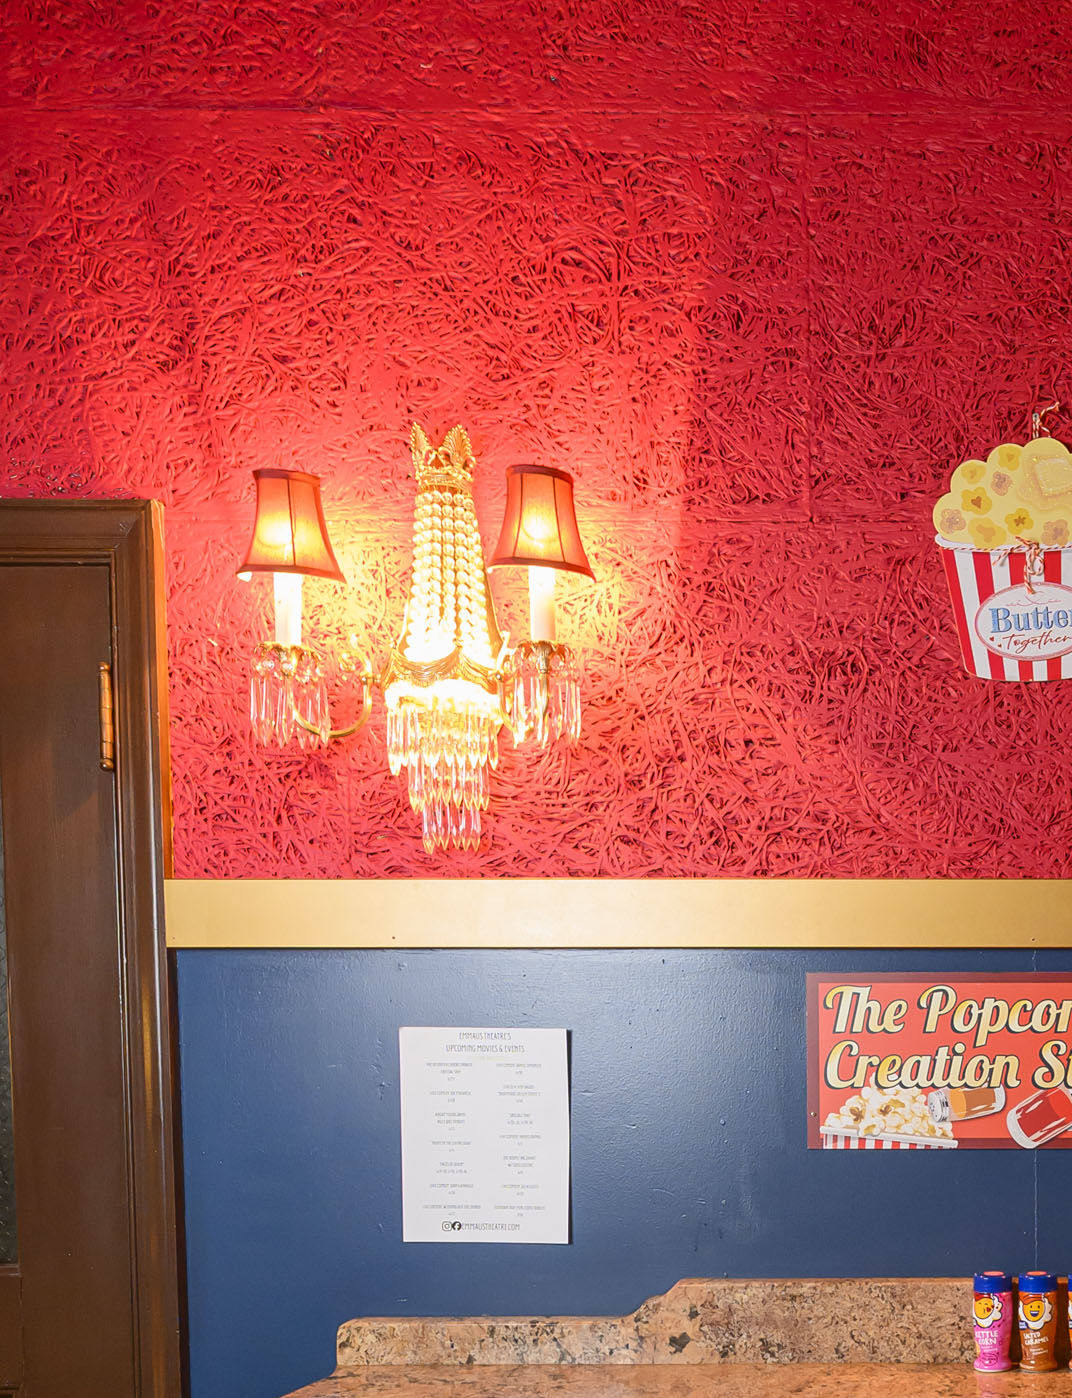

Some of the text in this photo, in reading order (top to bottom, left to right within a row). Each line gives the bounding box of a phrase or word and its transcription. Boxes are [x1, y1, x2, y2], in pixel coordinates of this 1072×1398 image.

[824, 985, 908, 1034] The
[445, 1044, 476, 1054] UPCOMING
[477, 1044, 499, 1054] MOVIES
[504, 1045, 525, 1054] EVENTS
[458, 1031, 484, 1041] EMMAUS
[824, 1039, 1022, 1090] Creation
